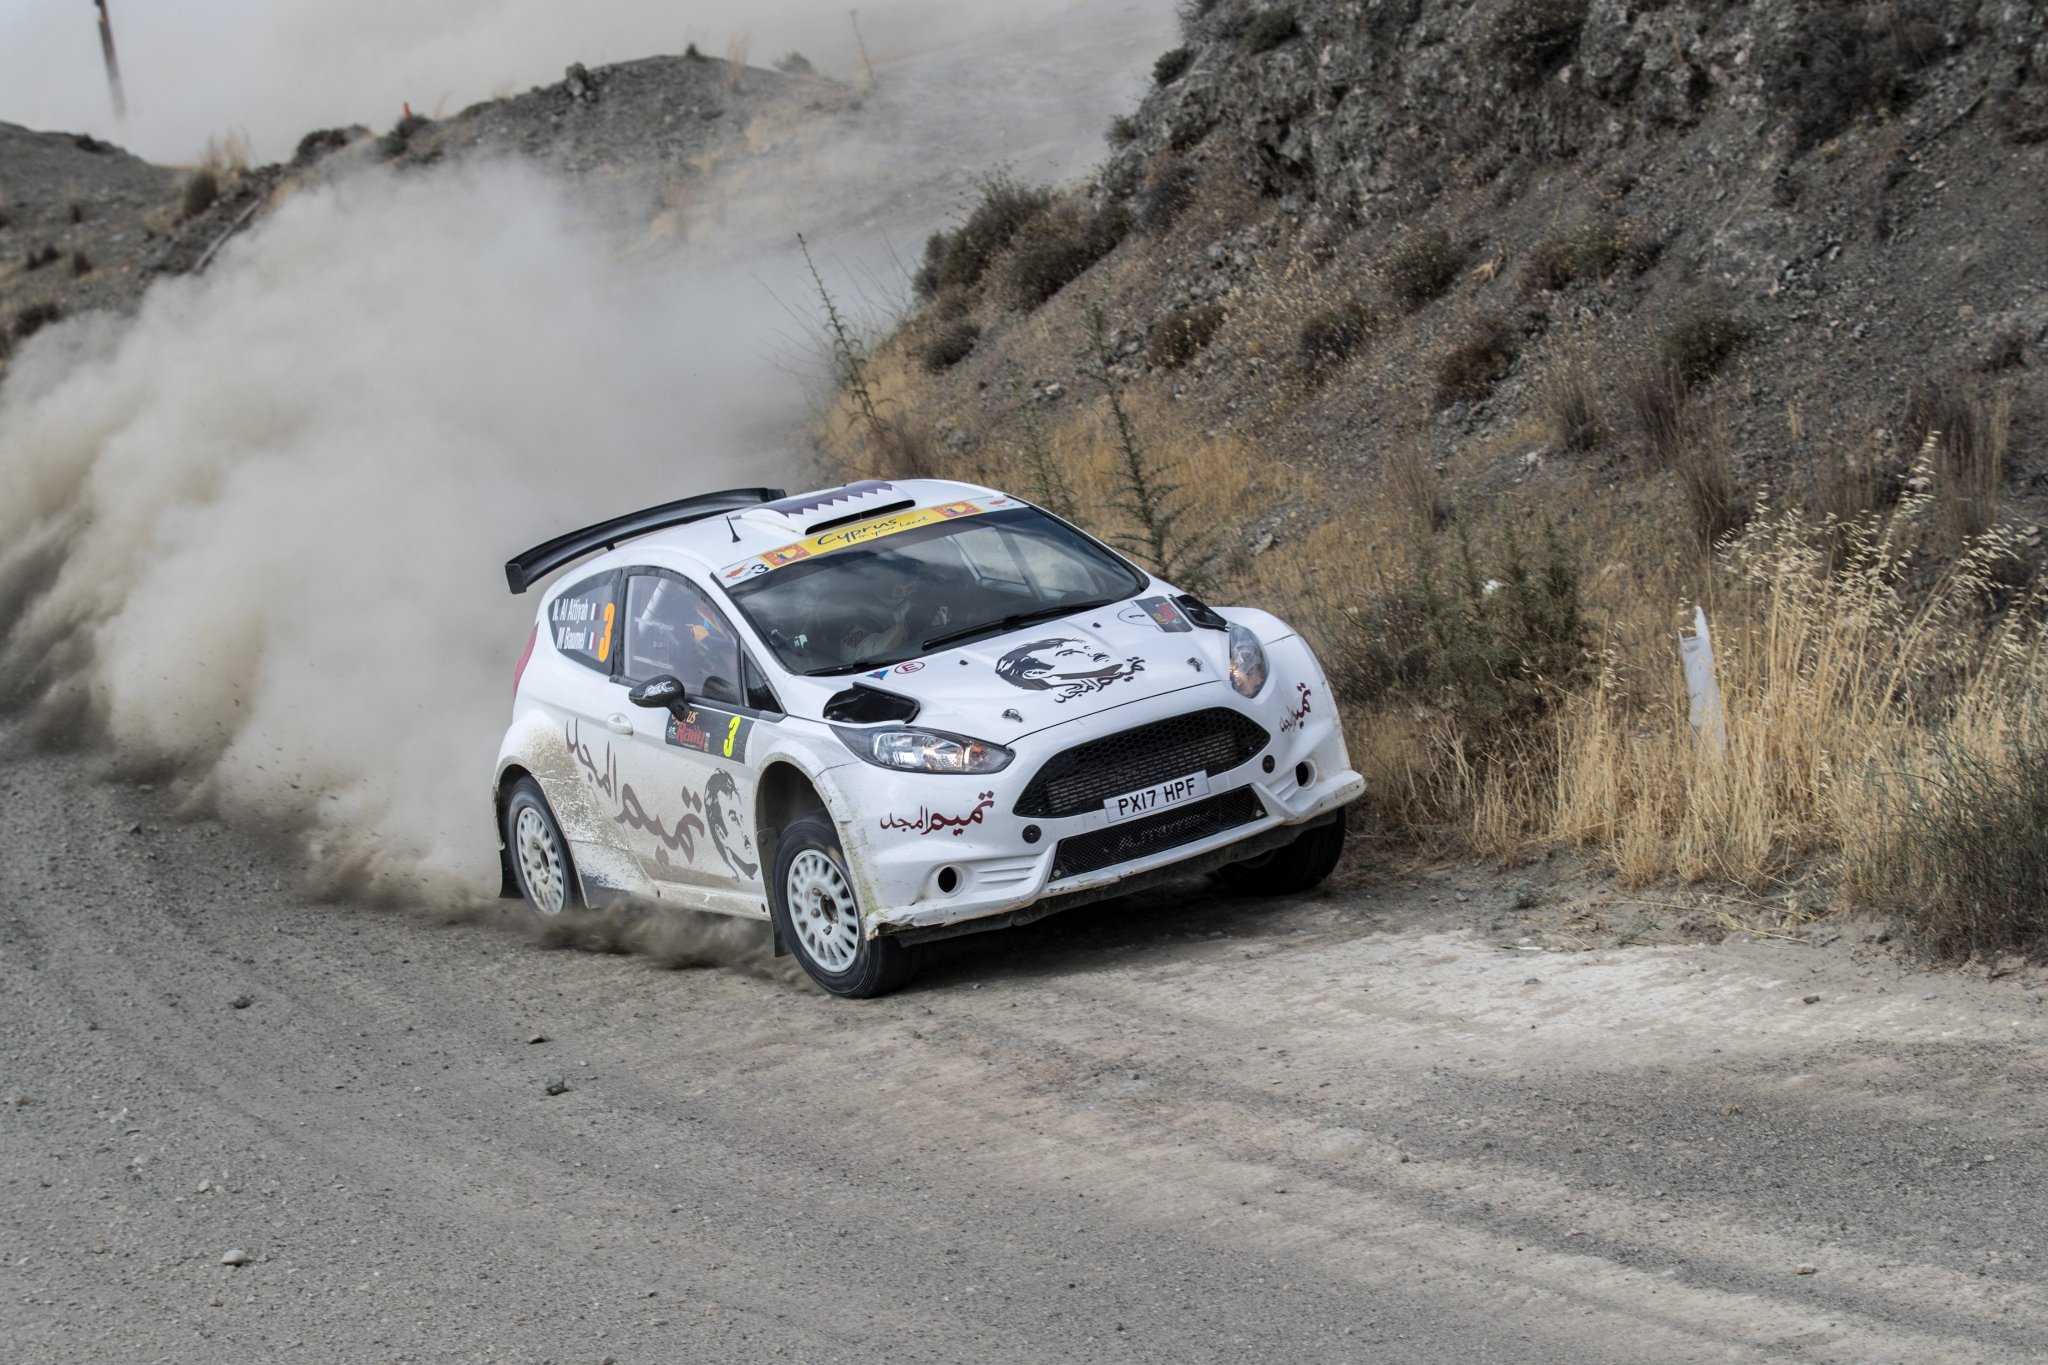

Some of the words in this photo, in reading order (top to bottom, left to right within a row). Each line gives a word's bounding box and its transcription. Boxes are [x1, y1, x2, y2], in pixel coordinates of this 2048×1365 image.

[817, 519, 897, 545] Cyprus
[899, 516, 928, 527] heart
[750, 564, 769, 574] 3
[598, 603, 615, 662] 3
[902, 663, 918, 672] E
[676, 721, 705, 750] Rally
[723, 716, 741, 757] 3
[1118, 790, 1156, 815] PX17
[1164, 778, 1195, 802] HPF
[880, 805, 928, 832] المجد
[920, 790, 994, 836] تميم
